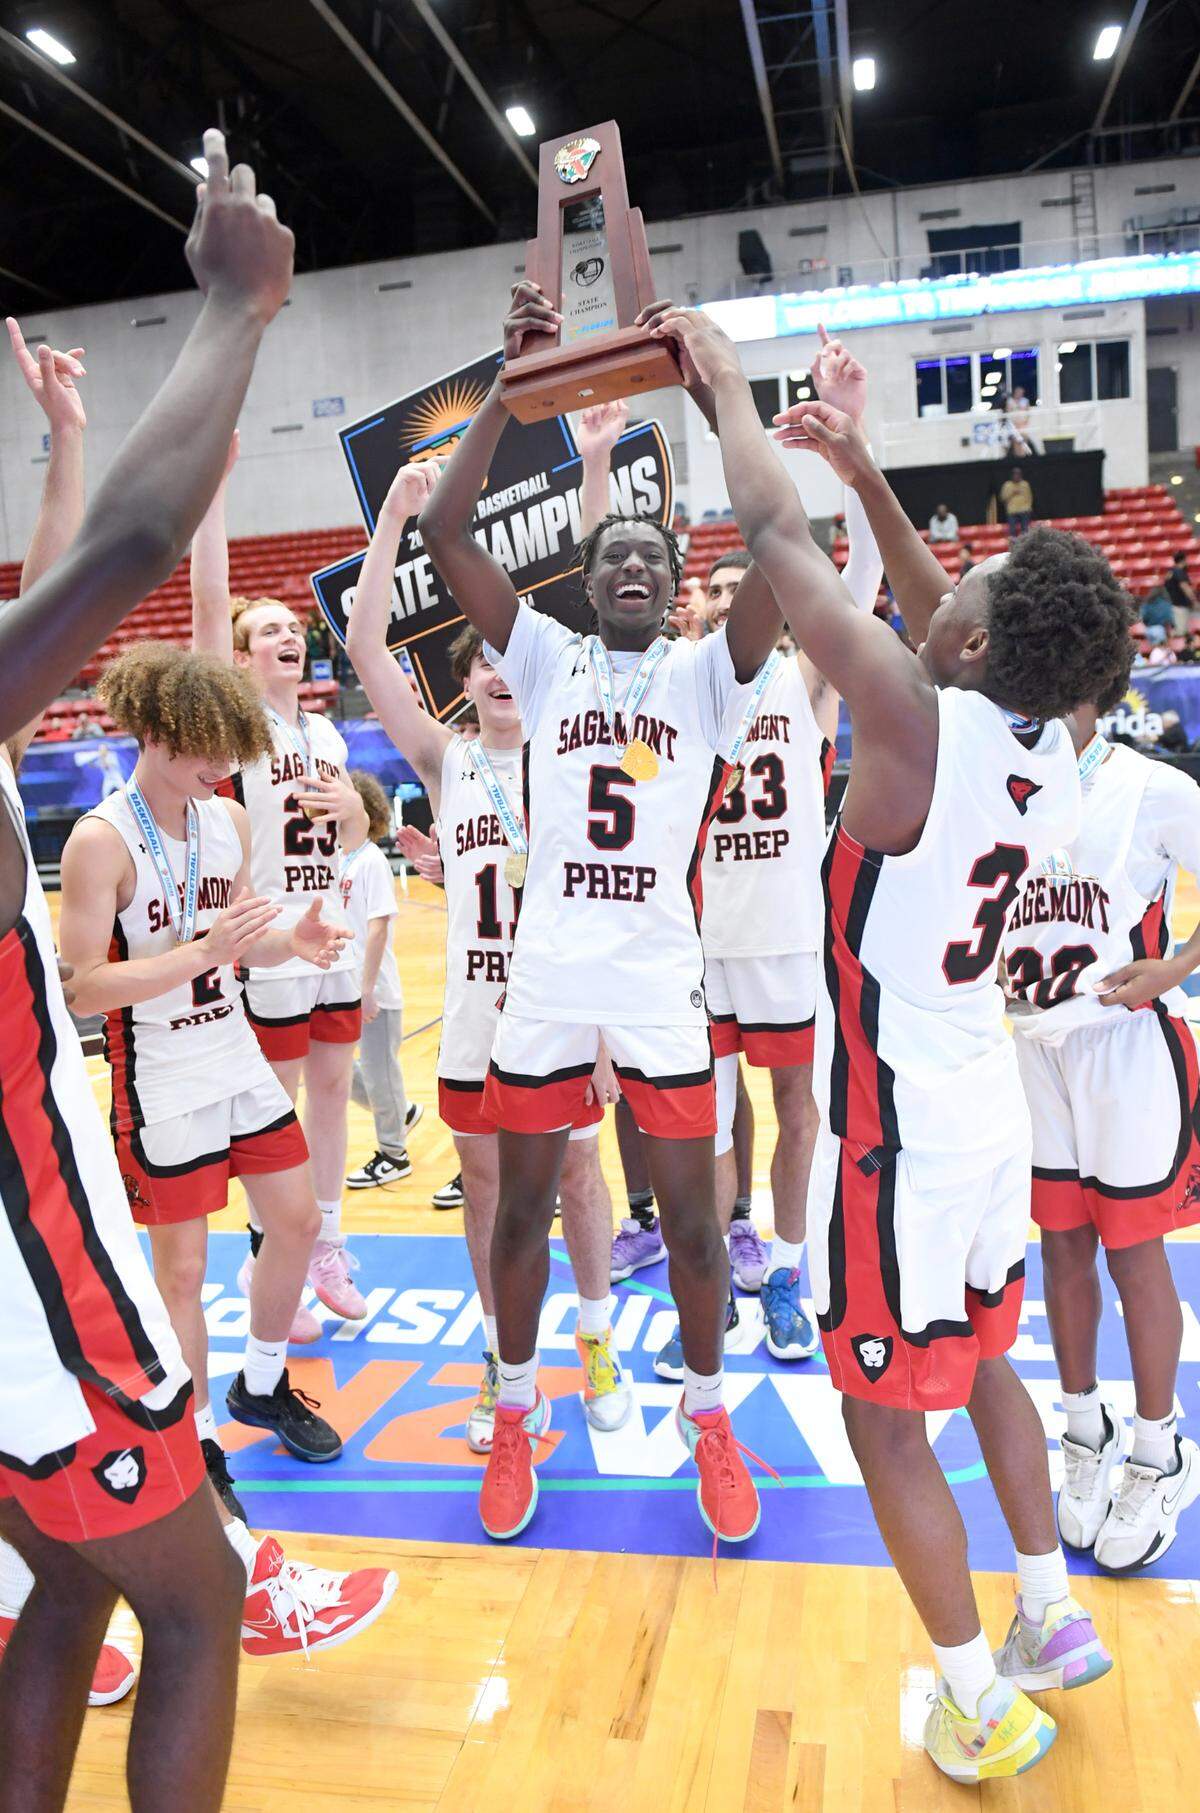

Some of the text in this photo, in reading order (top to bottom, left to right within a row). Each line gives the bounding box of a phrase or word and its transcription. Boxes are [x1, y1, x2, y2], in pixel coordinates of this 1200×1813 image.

[477, 471, 550, 520] BASKETBALL
[339, 552, 440, 629] SATE
[745, 713, 791, 744] MONT
[490, 783, 519, 839] BASKETBALL
[586, 763, 637, 852] 5
[716, 751, 788, 824] 33
[129, 792, 161, 858] BASKETBALL
[456, 813, 510, 857] SAGE
[713, 828, 790, 863] PREP
[187, 851, 197, 919] BASKETBALL
[563, 861, 657, 903] PREP
[1007, 877, 1111, 935] AGEMONT
[941, 841, 1030, 986] 3
